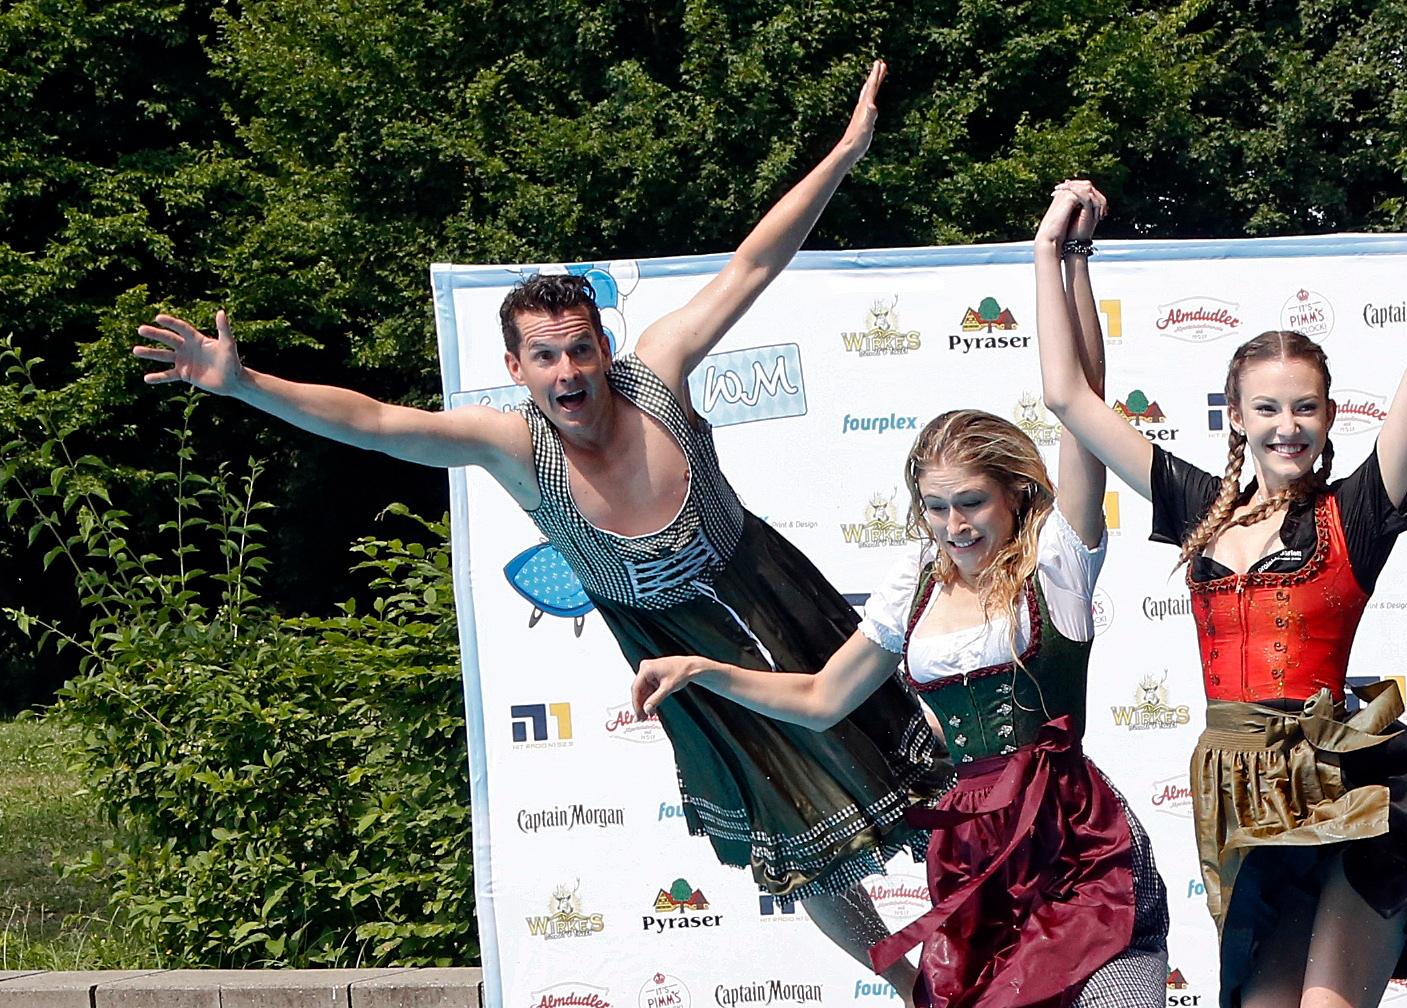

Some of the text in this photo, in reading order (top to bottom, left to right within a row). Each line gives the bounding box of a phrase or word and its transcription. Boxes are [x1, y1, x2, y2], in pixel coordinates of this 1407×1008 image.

[1156, 306, 1240, 330] Almdudler
[1289, 308, 1324, 328] PIMM'S
[950, 335, 1031, 354] Pyraser
[703, 356, 799, 413] WM
[842, 413, 918, 434] fourplex
[840, 523, 909, 544] WIRKE
[517, 804, 624, 834] Captain Morgan
[642, 914, 723, 934] Pyraser
[714, 979, 822, 1008] Captain Morgan
